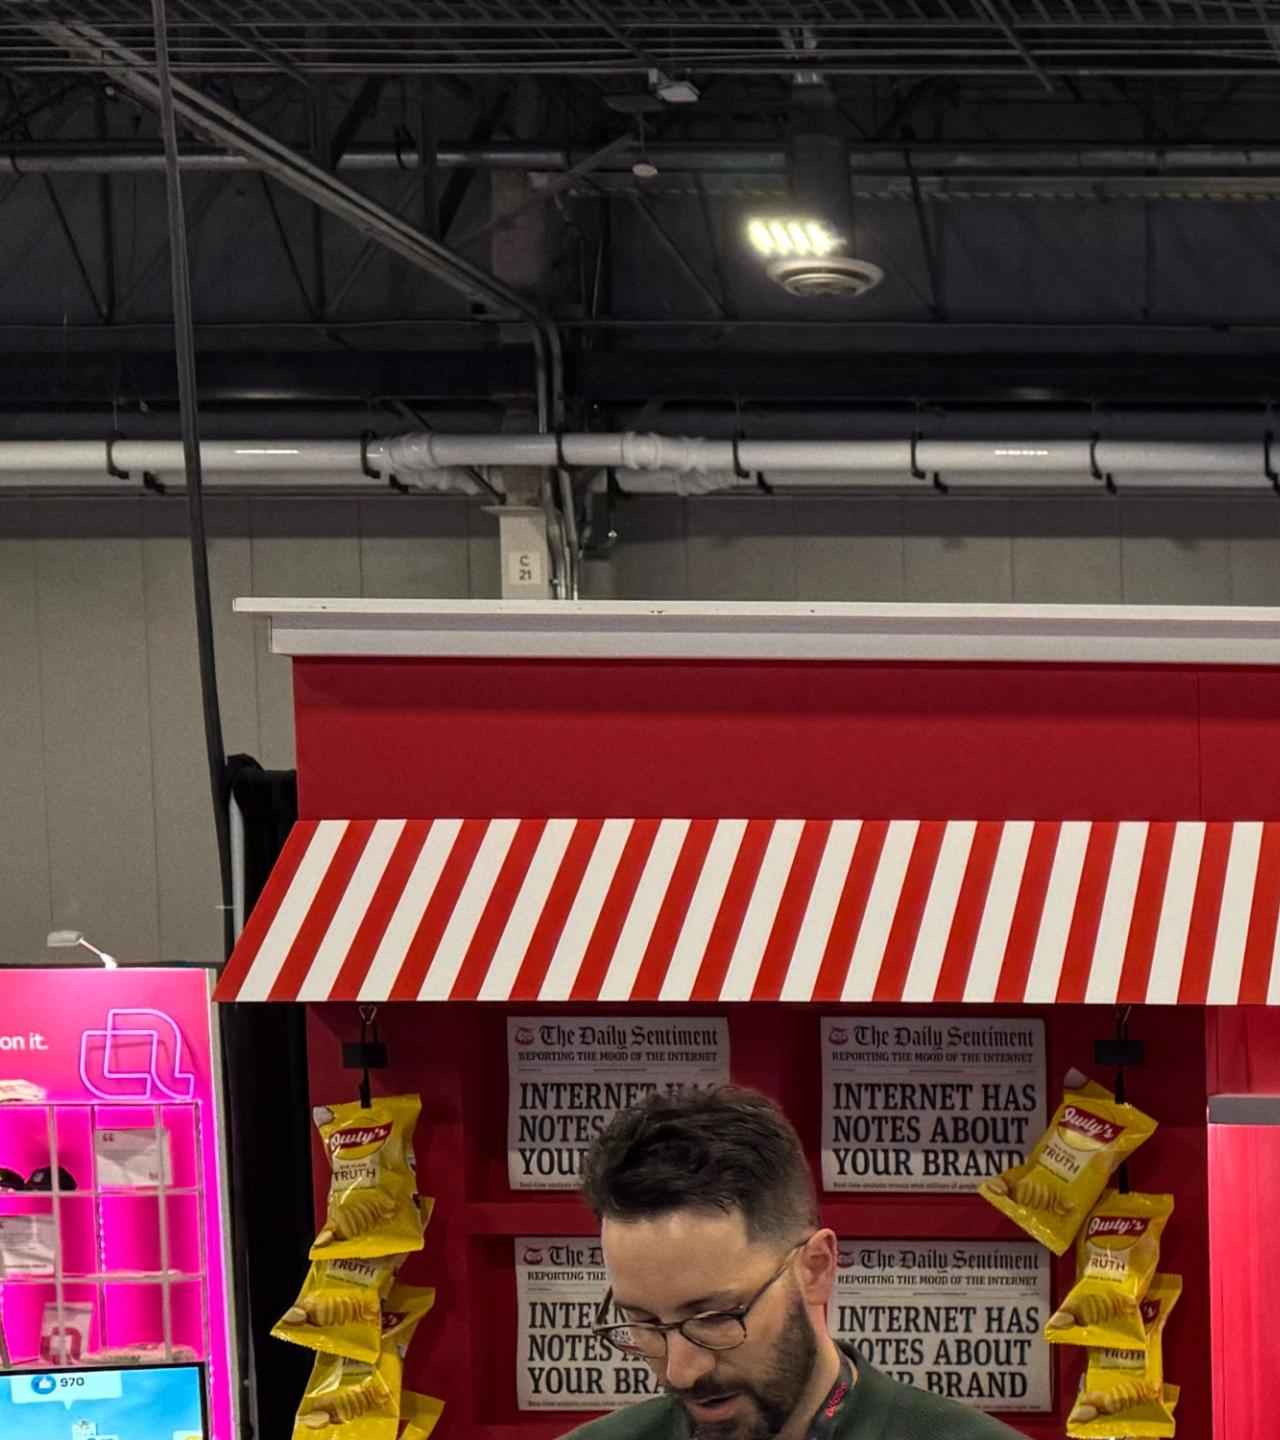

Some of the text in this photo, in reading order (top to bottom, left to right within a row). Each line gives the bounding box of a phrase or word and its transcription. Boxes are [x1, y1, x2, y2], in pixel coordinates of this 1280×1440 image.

[519, 554, 530, 567] C
[519, 569, 532, 580] 21
[539, 1025, 719, 1049] The Daily Sentiment
[854, 1025, 1034, 1050] The Daily Sentiment
[518, 1051, 718, 1062] REPORTING THE MOOD OF THE INTERNET
[832, 1051, 1033, 1063] REPORTING THE MOOD OF THE INTERNET
[833, 1083, 1037, 1112] INTERNET HAS
[519, 1115, 605, 1142] NOTES
[833, 1115, 1029, 1144] NOTES ABOUT
[833, 1148, 1026, 1177] YOUR BRAND
[1042, 1145, 1080, 1175] TRUTH
[333, 1168, 376, 1182] TRUTH
[331, 1259, 376, 1277] TRUTH
[548, 1246, 583, 1267] The
[860, 1249, 1040, 1273] The Daily Sentiment
[1091, 1258, 1126, 1272] RUTH
[527, 1271, 607, 1281] REPORTING THE
[838, 1275, 1038, 1286] REPORTING THE MOOD OF THE INTERNET
[838, 1306, 1040, 1334] INTERNET HAS
[528, 1335, 612, 1362] NOTES
[933, 1340, 1031, 1366] ABOUT
[60, 1376, 85, 1388] 970
[527, 1367, 605, 1394] YOUR
[926, 1372, 1028, 1399] BRAND
